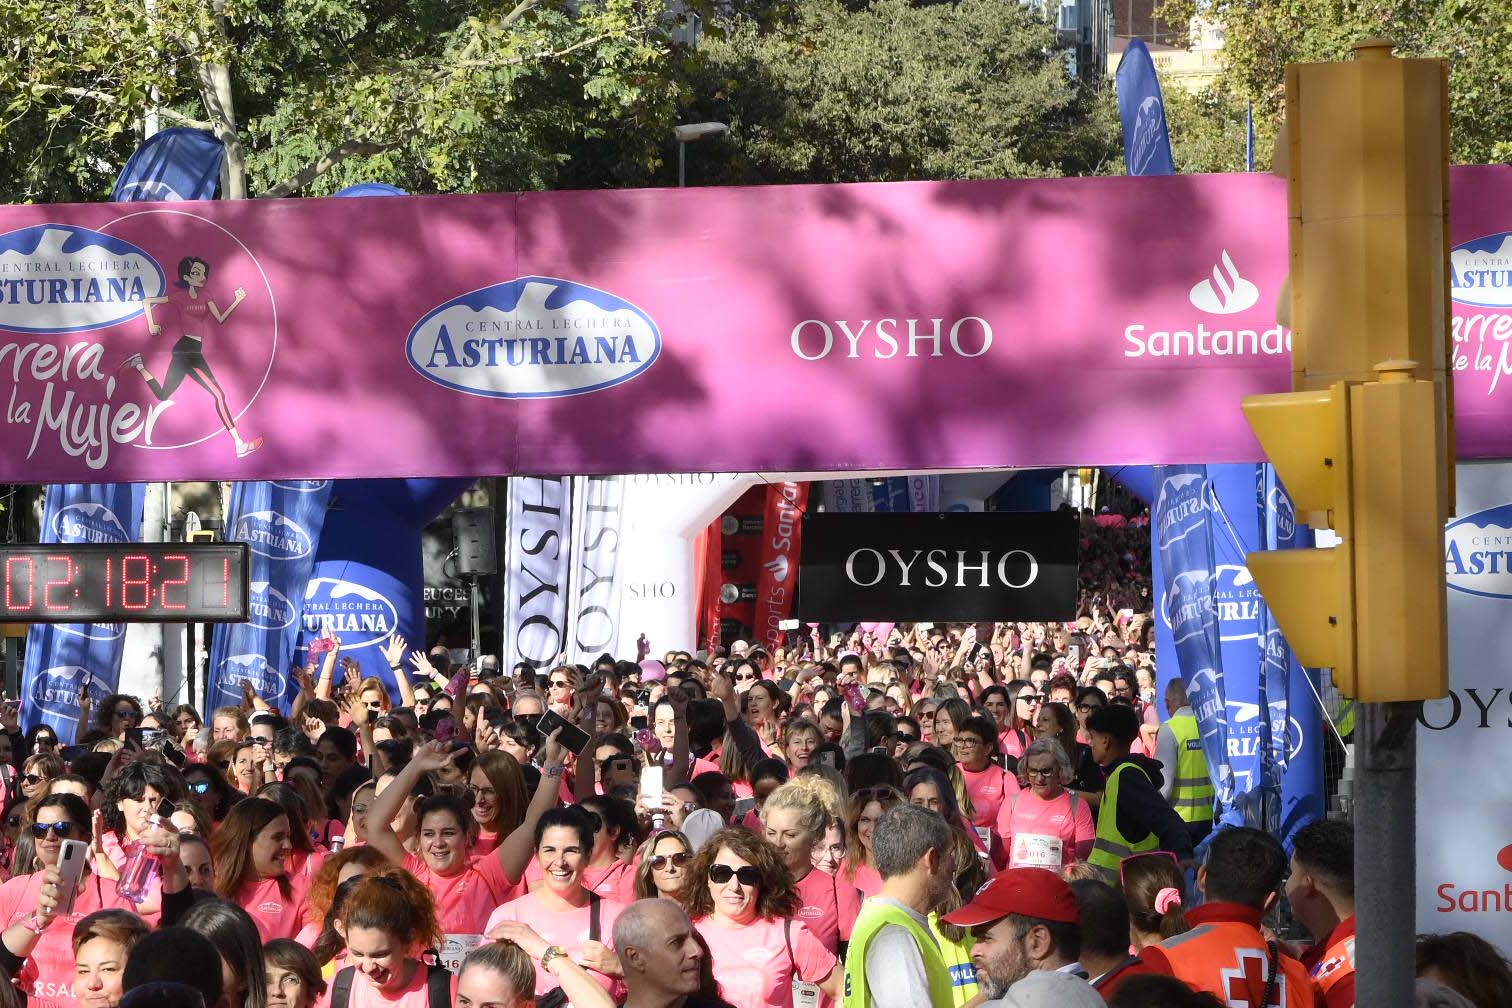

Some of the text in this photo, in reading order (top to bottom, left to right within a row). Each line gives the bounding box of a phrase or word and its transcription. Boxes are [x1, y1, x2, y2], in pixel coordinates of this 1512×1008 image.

[68, 259, 141, 271] LECHERA
[465, 317, 633, 332] CENTRAL LECHERA
[791, 316, 993, 360] OYSHO
[1125, 324, 1293, 359] Santand
[426, 324, 640, 368] ASTURIANA
[7, 386, 31, 424] la
[26, 377, 174, 470] Mujer
[5, 553, 230, 611] 02:18:21
[845, 547, 1039, 589] OYSHO
[335, 602, 384, 611] LECHERA
[444, 959, 460, 969] 16
